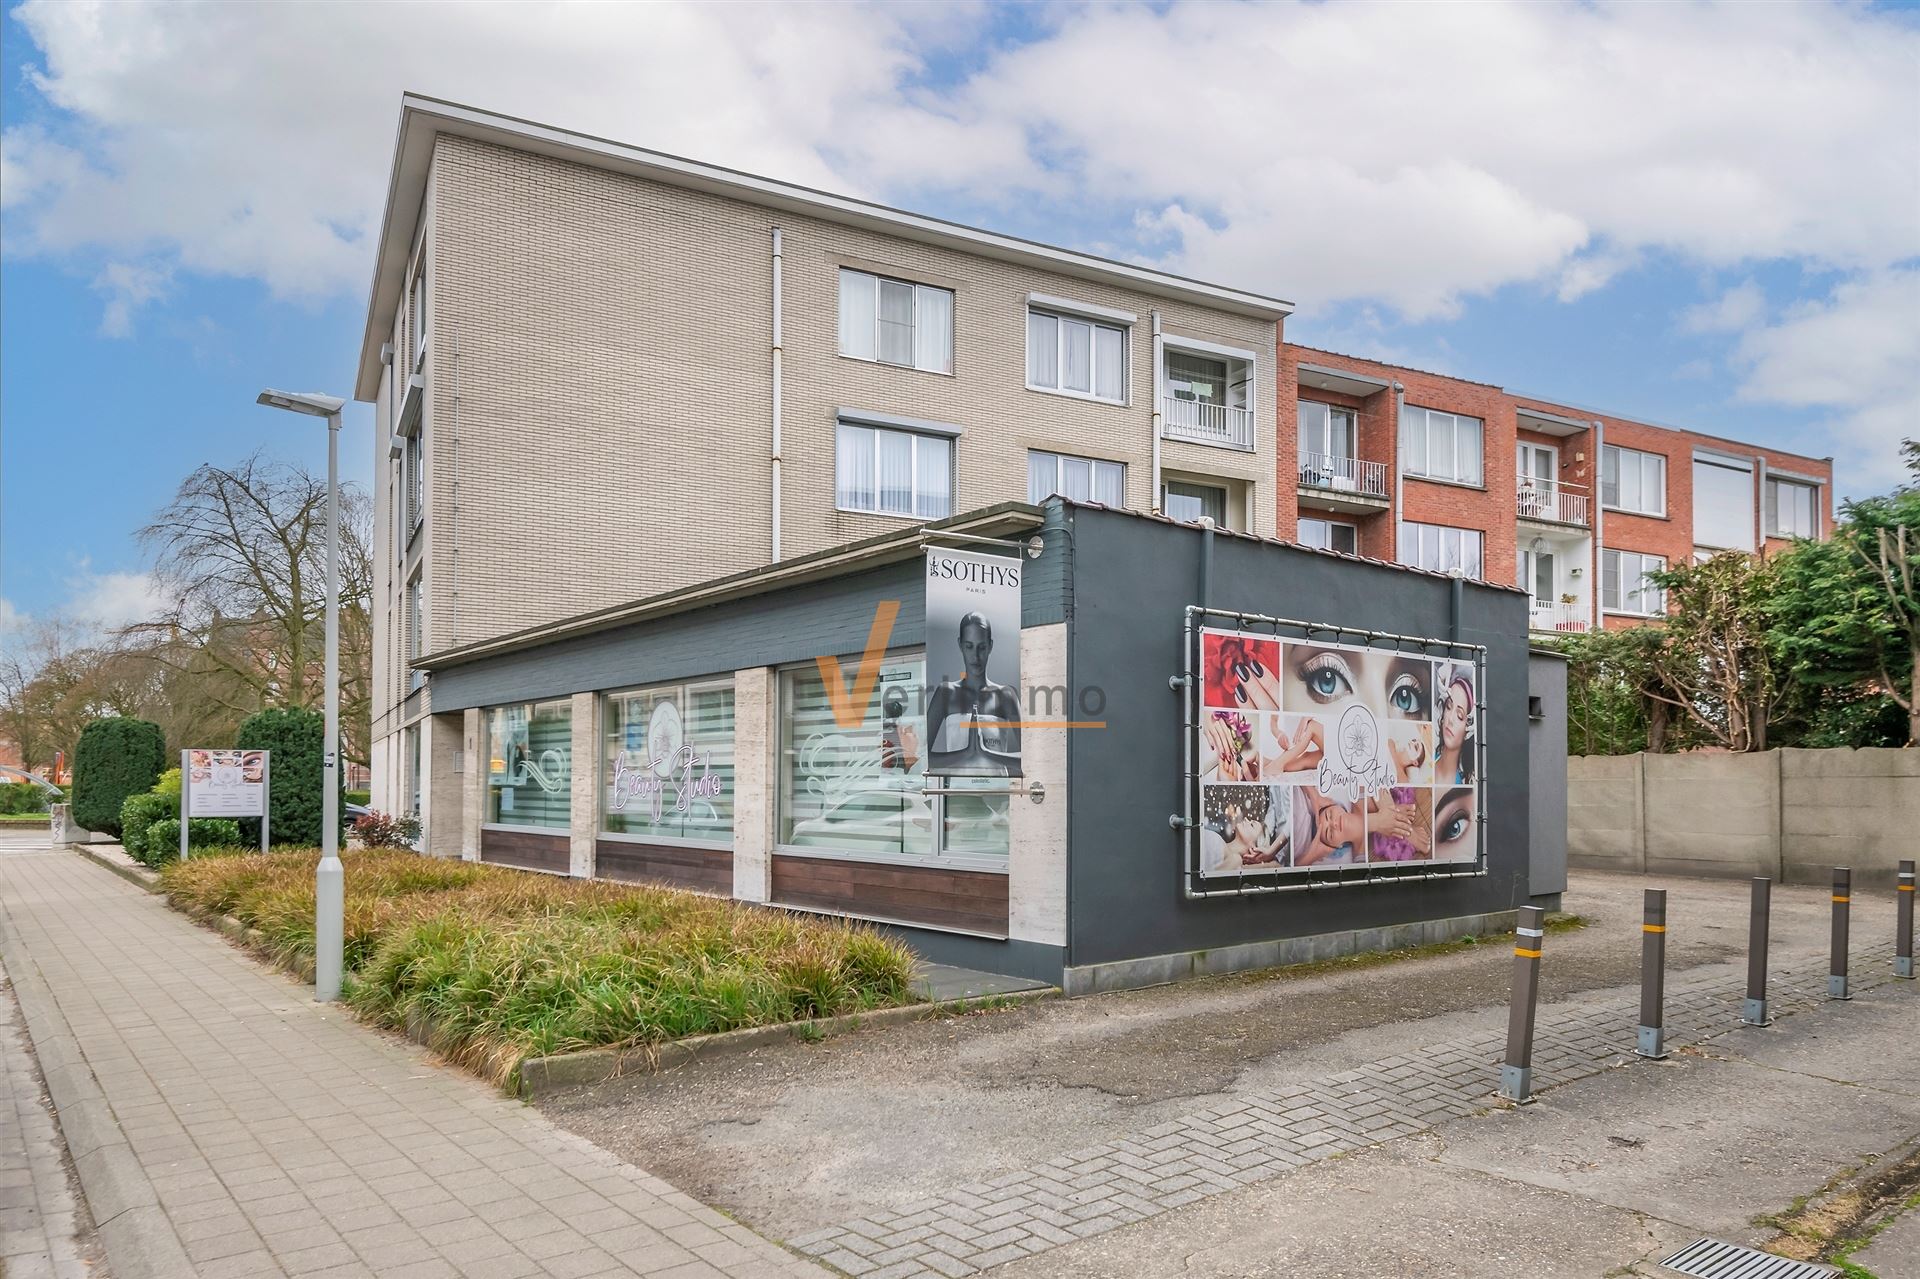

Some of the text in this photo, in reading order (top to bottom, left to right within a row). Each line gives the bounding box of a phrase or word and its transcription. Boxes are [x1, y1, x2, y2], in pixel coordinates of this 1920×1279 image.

[940, 557, 1020, 589] SOTHYS
[965, 586, 987, 595] PARIS
[613, 740, 722, 822] Beauty Studio
[1319, 757, 1396, 800] Beauty Studio
